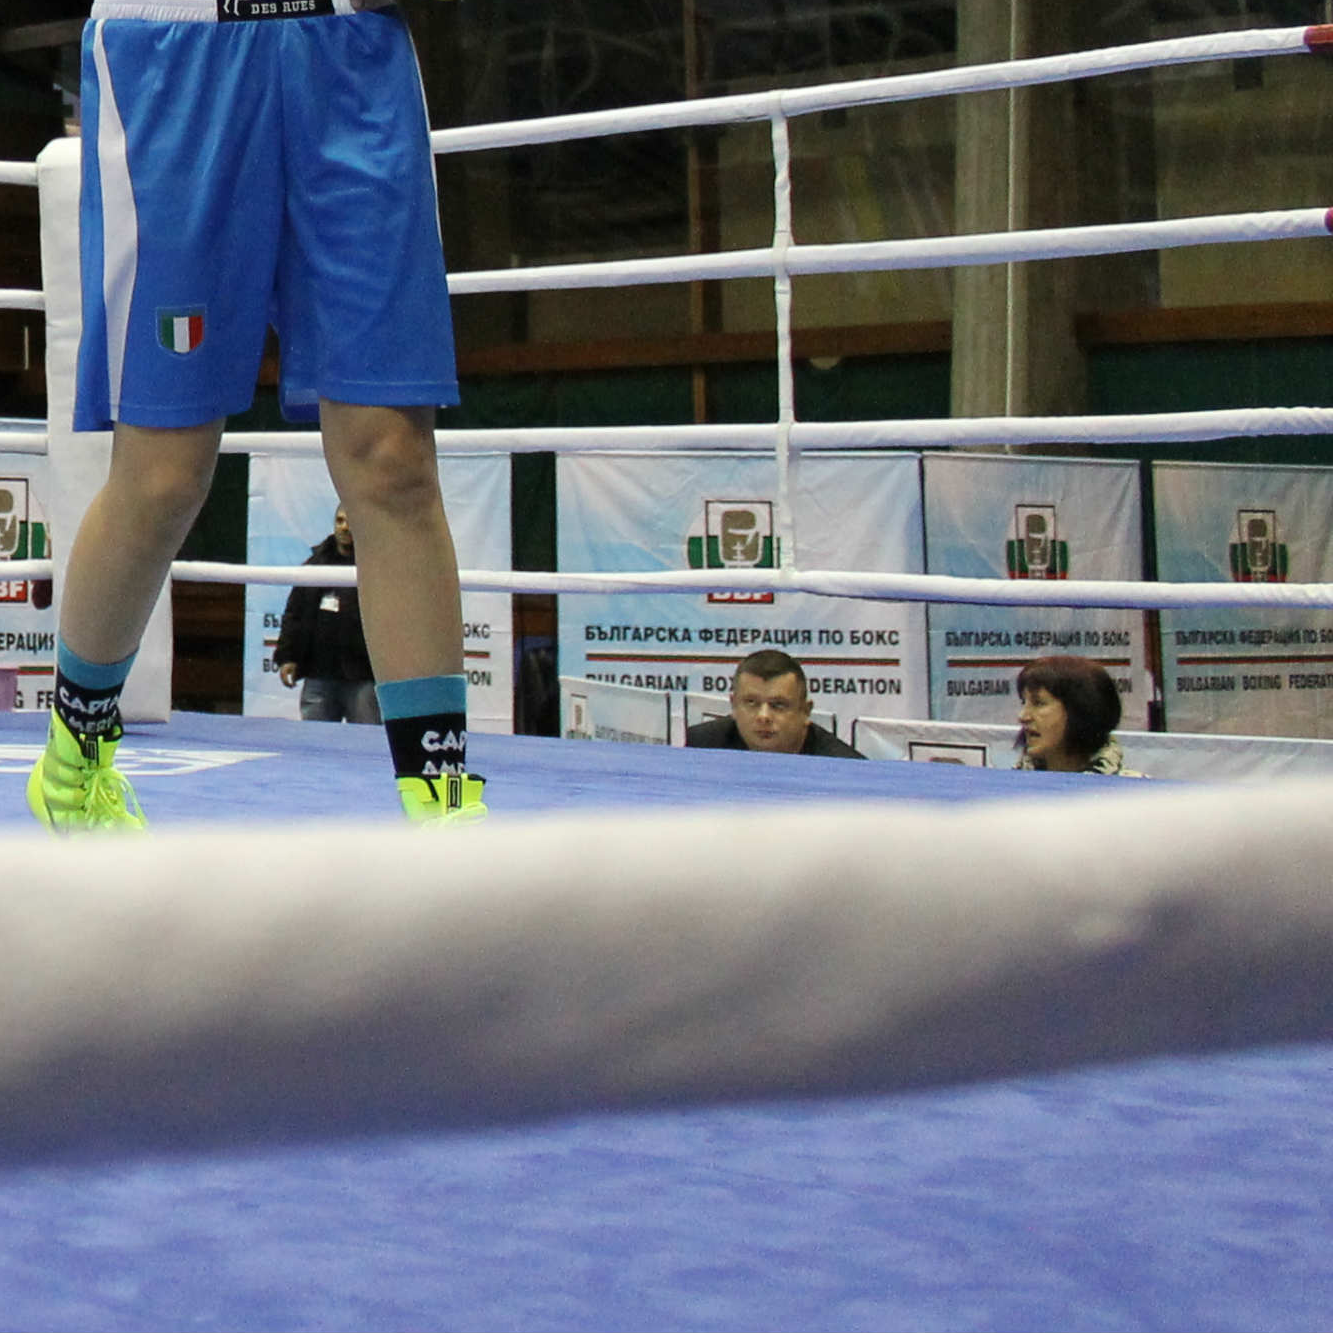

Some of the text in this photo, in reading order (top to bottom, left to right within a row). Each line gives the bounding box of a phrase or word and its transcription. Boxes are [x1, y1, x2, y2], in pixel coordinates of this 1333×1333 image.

[251, 0, 316, 15] DES RUES
[463, 623, 491, 639] ОКС
[585, 625, 900, 647] БЪЛГАРСКА ФЕДЕРАЦИЯ ПО БОКС
